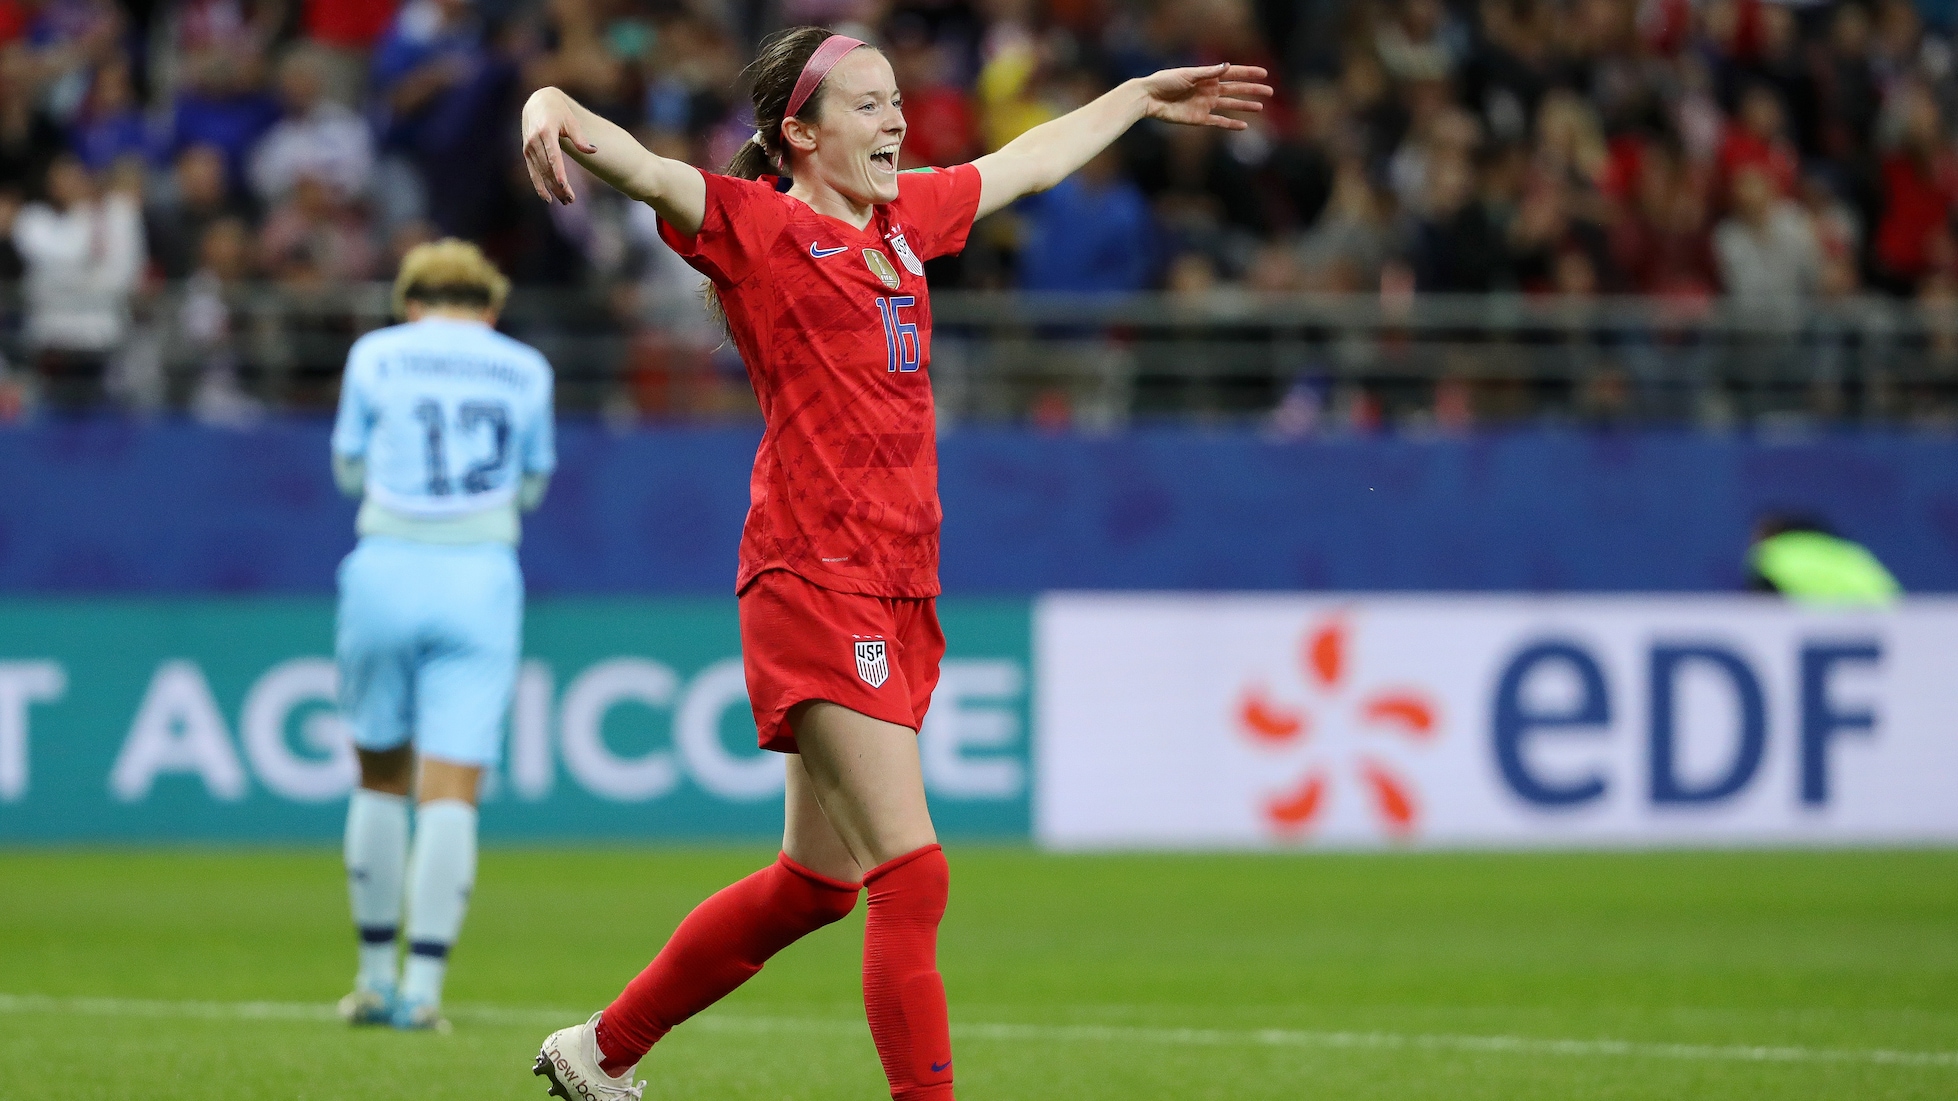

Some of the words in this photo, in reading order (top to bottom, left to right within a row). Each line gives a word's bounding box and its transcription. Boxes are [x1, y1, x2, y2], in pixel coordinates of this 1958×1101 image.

[875, 296, 920, 372] 16
[415, 400, 511, 496] 12
[857, 644, 884, 662] USA
[108, 656, 1022, 801] AGICOE
[549, 1048, 579, 1083] new
